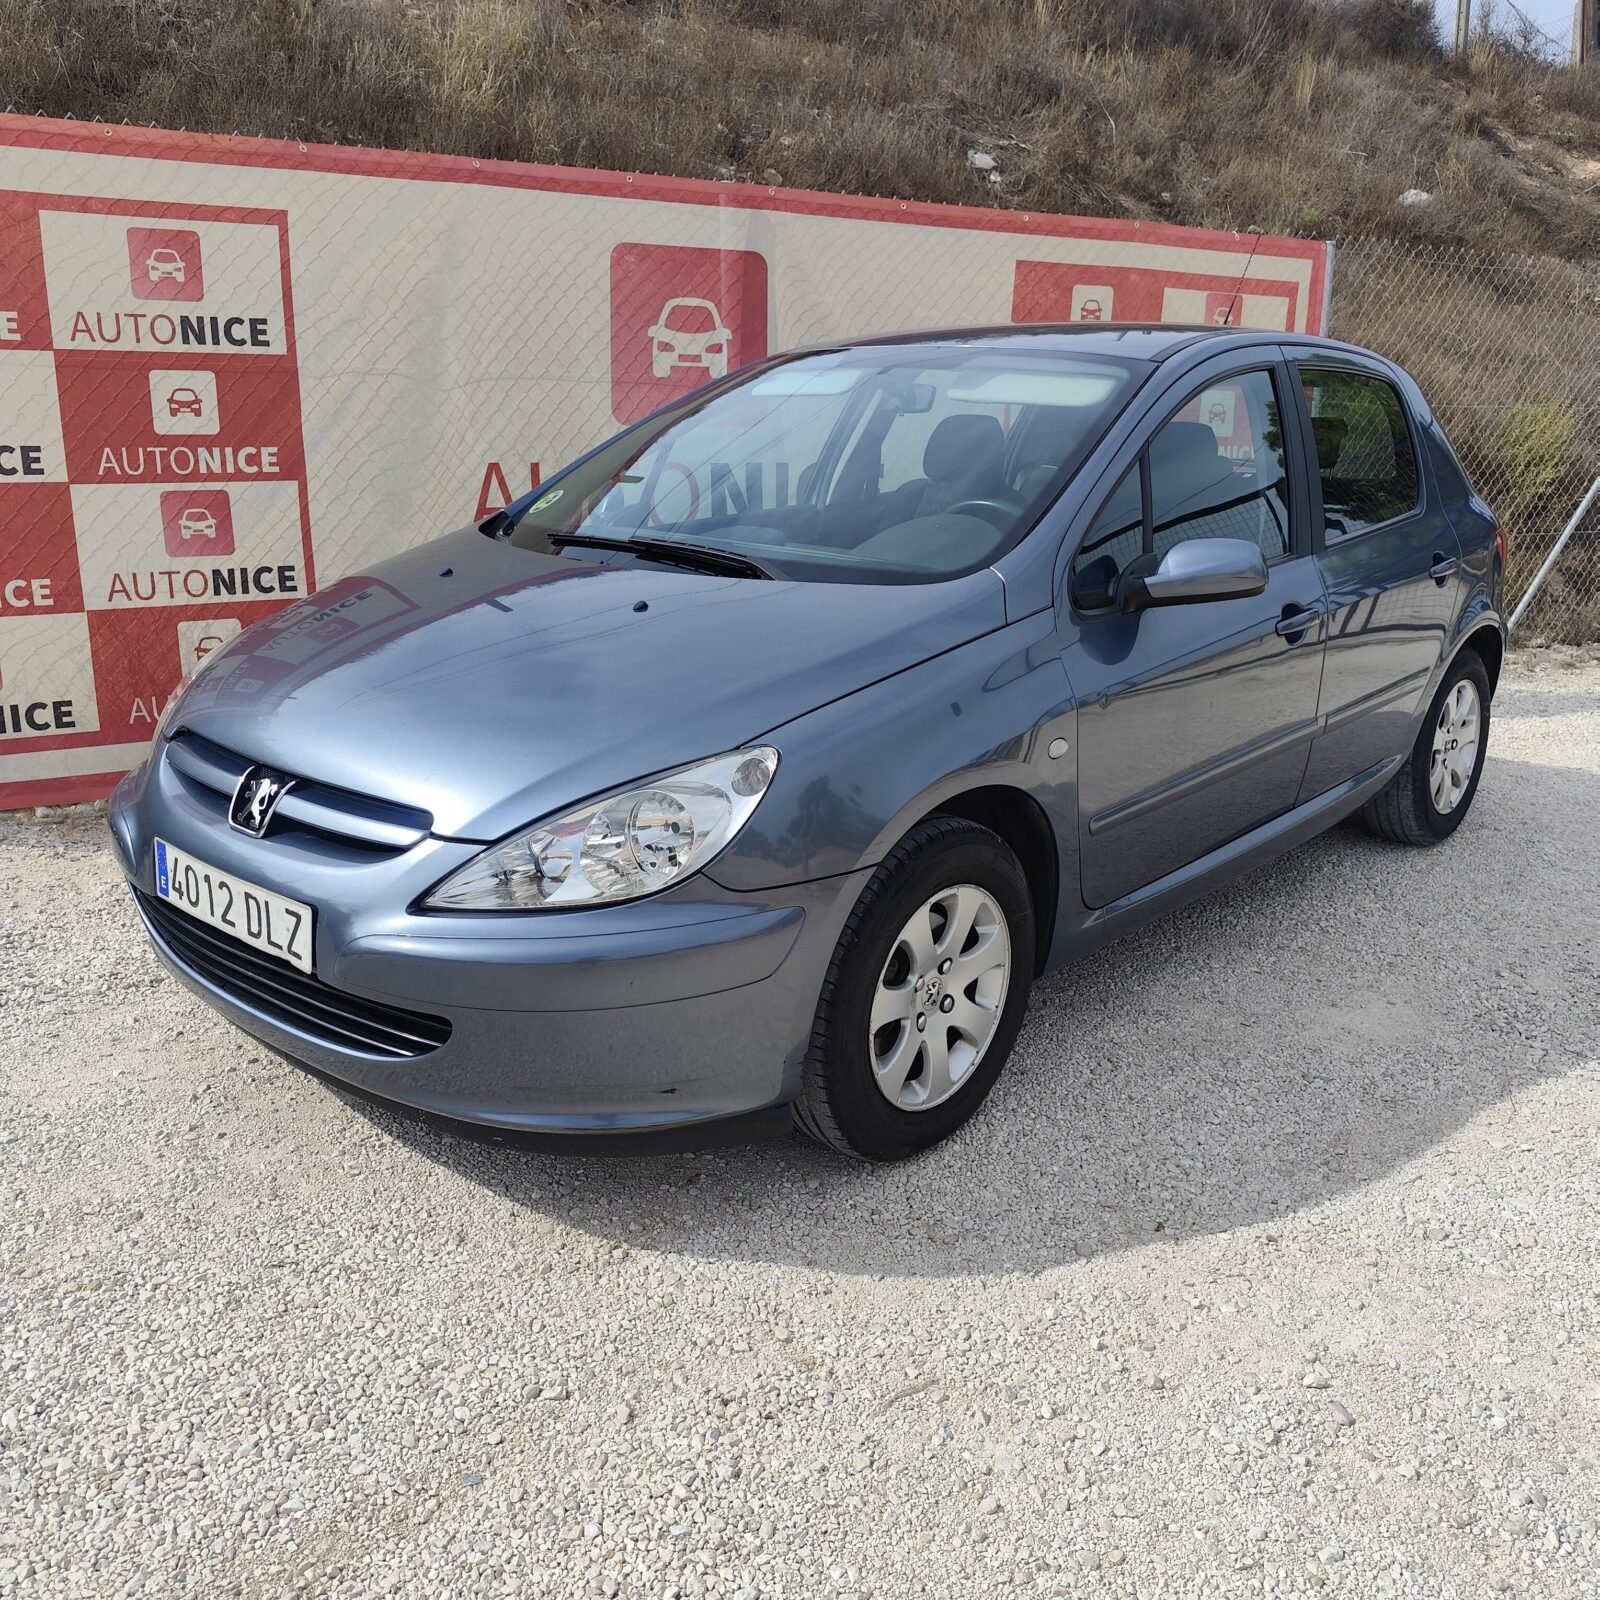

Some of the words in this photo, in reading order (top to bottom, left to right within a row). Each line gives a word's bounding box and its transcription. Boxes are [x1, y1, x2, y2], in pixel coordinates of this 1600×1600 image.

[70, 311, 271, 347] AUTONICE
[98, 446, 281, 476] AUTONICE
[107, 565, 298, 602] AUTONICE
[171, 856, 236, 929] 4012
[244, 891, 303, 961] DLZ
